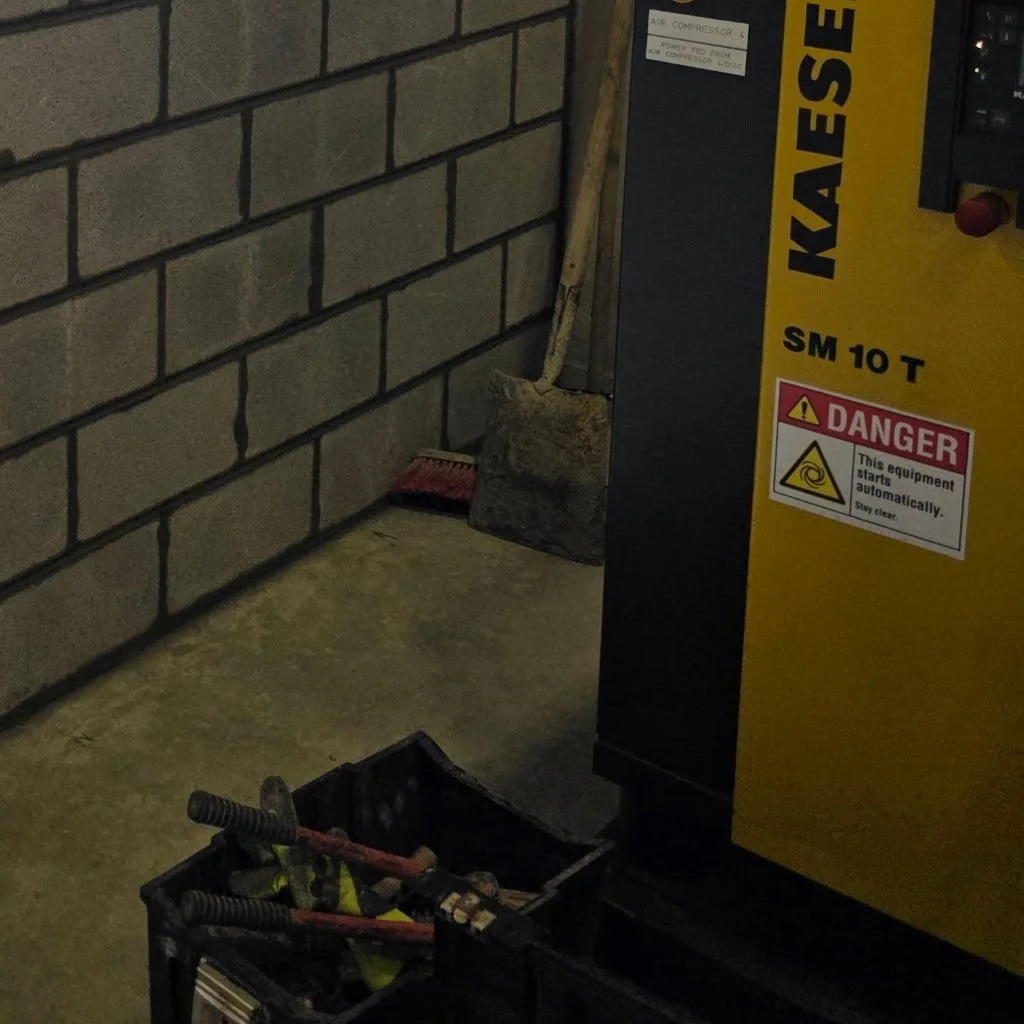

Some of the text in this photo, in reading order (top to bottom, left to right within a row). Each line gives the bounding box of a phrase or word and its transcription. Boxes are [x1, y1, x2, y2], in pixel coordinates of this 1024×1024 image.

[650, 18, 666, 26] AIR
[672, 21, 733, 37] COMPRESSOR
[648, 48, 661, 56] AIR
[666, 51, 713, 65] COMPRESSOR
[661, 42, 731, 59] POWER FED FROM
[783, 326, 925, 383] SM 10 T
[827, 403, 958, 465] DANGER
[856, 469, 891, 487] starts
[858, 453, 955, 492] This equipment
[856, 481, 944, 518] automatically.
[855, 501, 898, 521] Stay clear.
